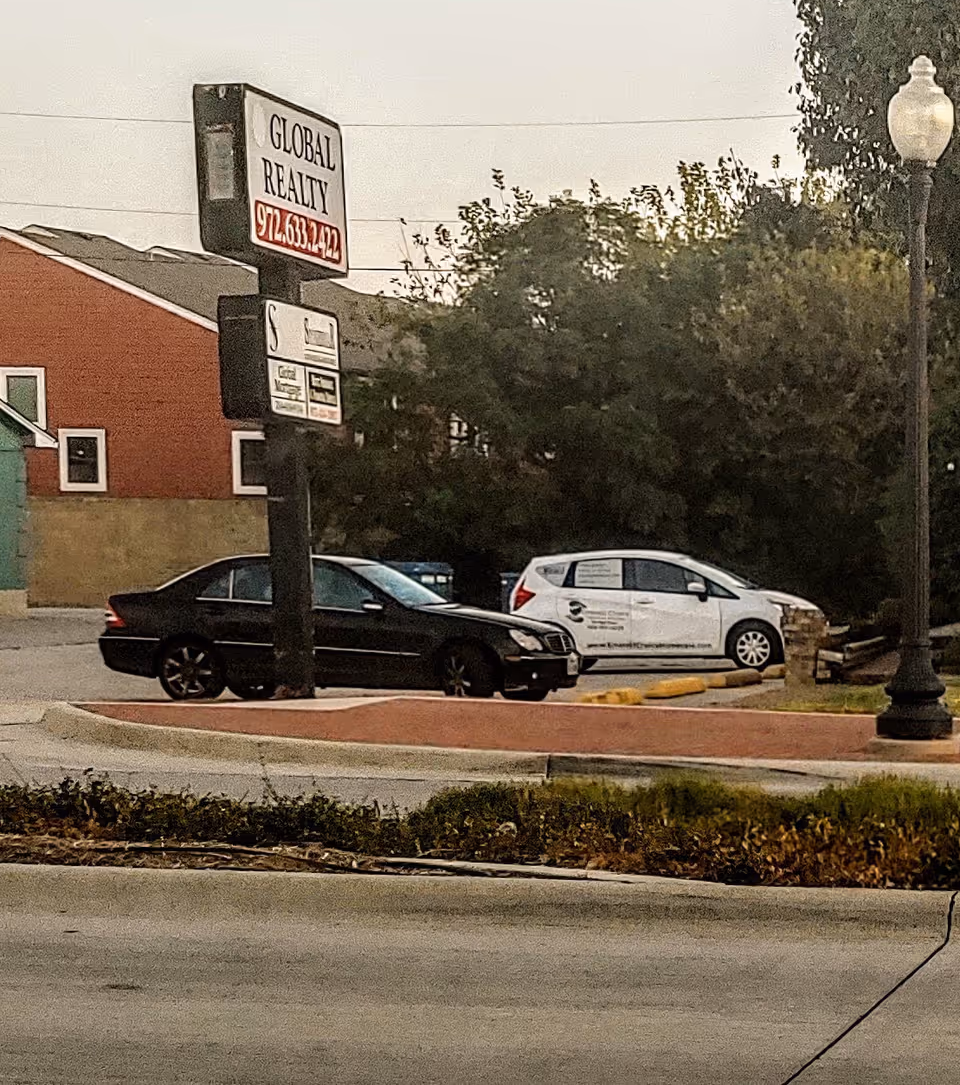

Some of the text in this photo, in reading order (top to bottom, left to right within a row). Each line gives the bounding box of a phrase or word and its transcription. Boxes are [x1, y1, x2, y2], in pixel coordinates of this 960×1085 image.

[270, 114, 335, 171] GLOBAL
[262, 157, 328, 215] REALTY
[257, 203, 339, 259] 972.633.2422
